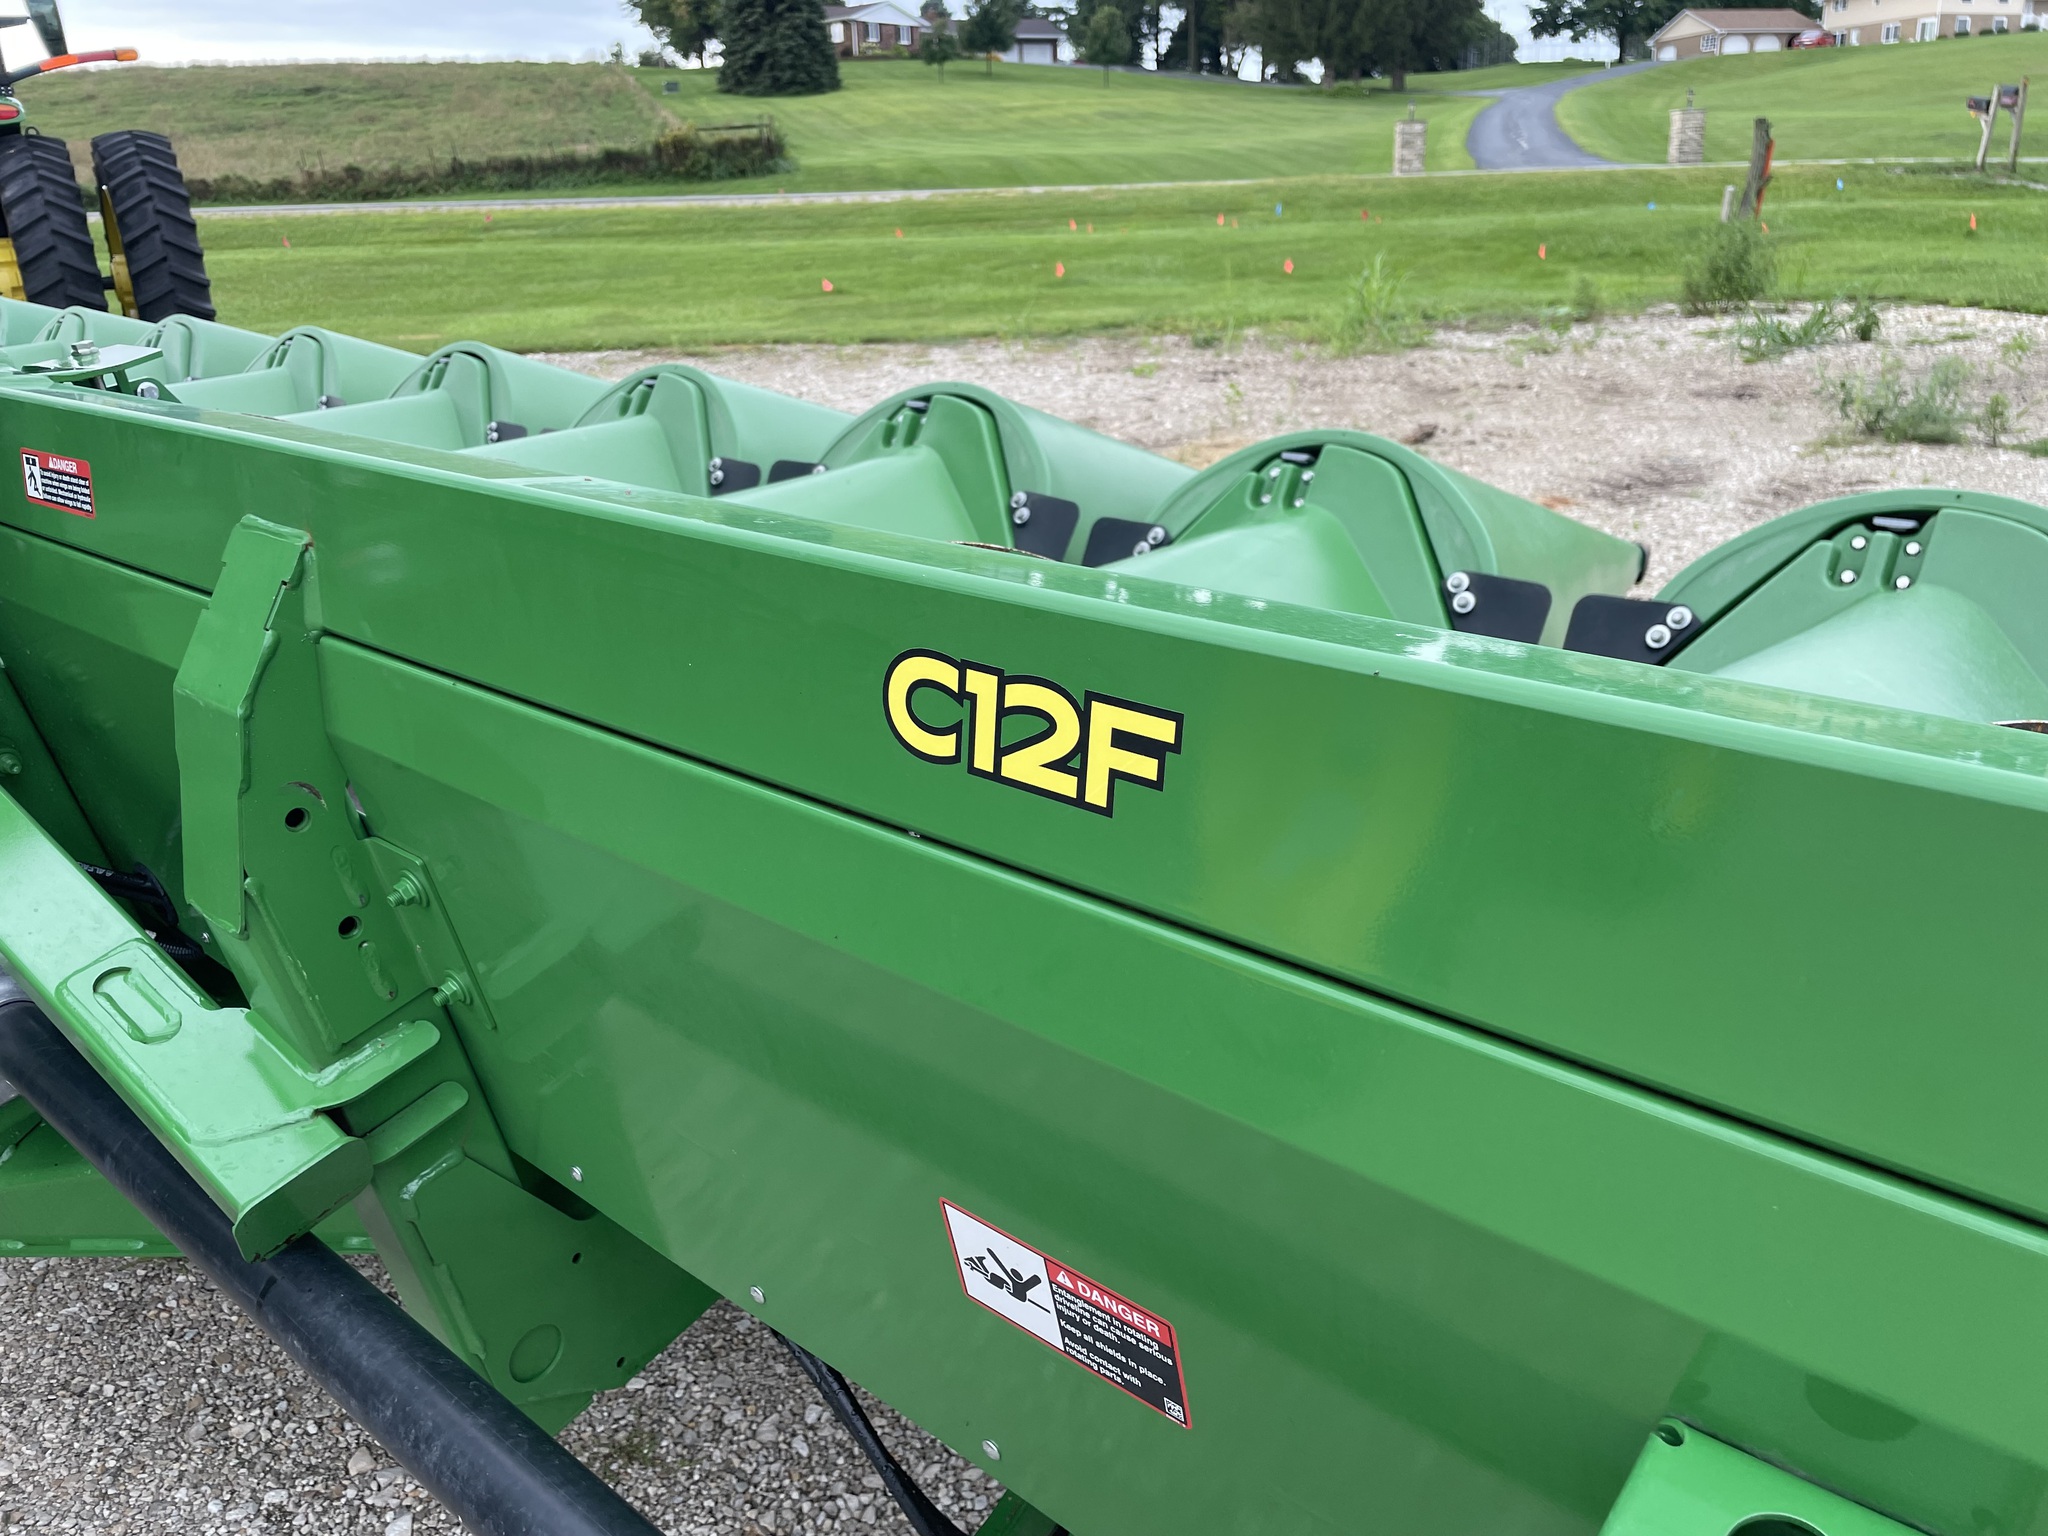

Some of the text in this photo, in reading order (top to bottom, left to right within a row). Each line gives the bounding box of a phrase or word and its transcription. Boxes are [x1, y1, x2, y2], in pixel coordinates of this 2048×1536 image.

[53, 458, 77, 474] DANGER
[885, 650, 1182, 815] C12F
[1052, 1283, 1159, 1350] Entanglement in rotating
[1055, 1294, 1172, 1365] driveline can cause serious
[1056, 1302, 1120, 1344] injury or death.
[1077, 1280, 1160, 1337] DANGER
[1060, 1319, 1166, 1386] Keep all shields in place.
[1065, 1337, 1141, 1387] Avoid contact with
[1066, 1346, 1124, 1385] rotating parts.
